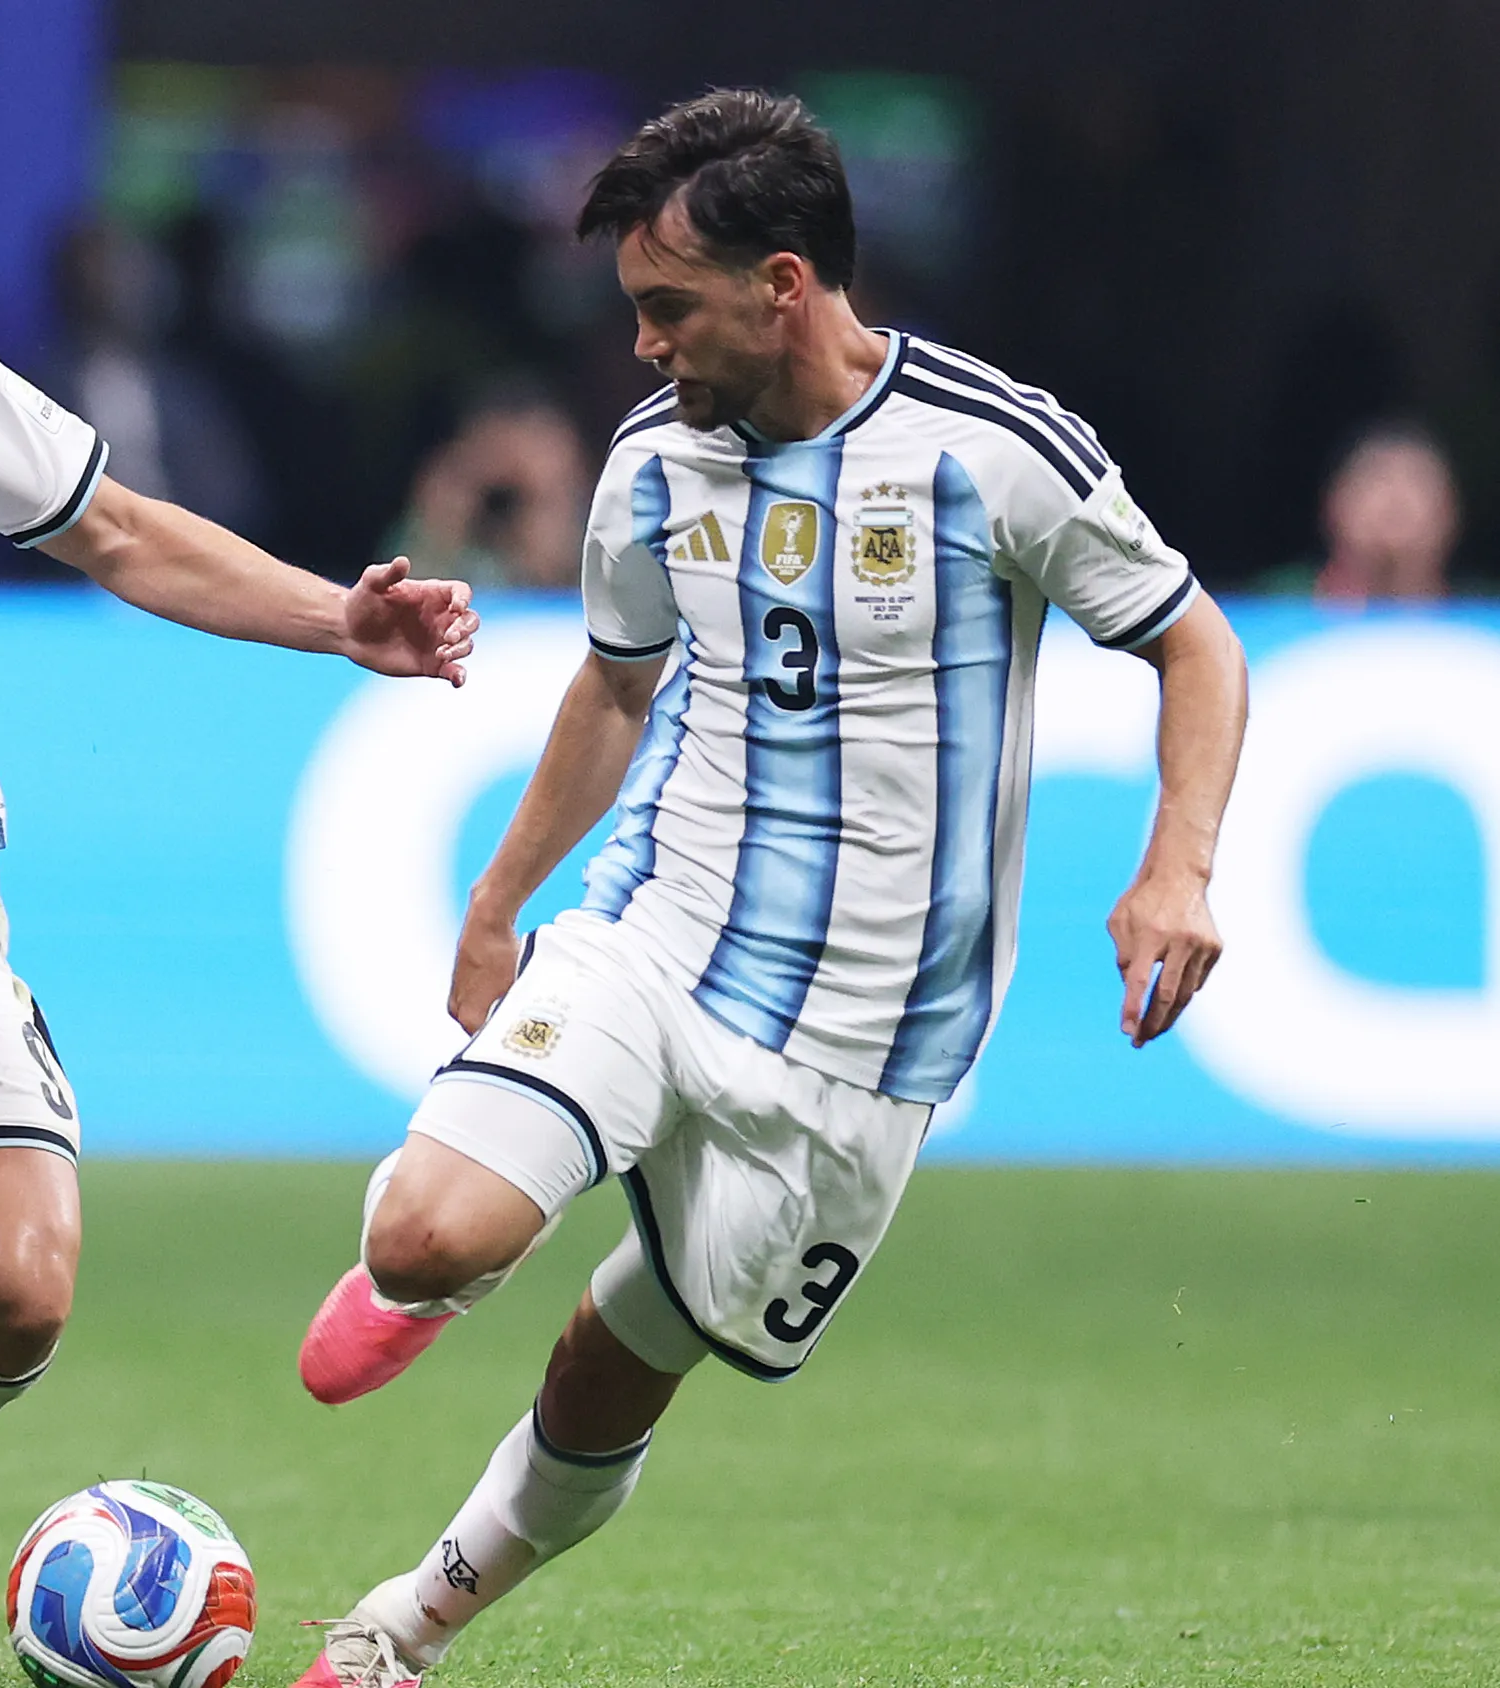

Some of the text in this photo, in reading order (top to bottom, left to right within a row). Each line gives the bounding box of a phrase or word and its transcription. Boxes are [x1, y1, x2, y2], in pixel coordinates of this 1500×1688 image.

[863, 527, 903, 565] AFA
[763, 606, 819, 712] 3
[21, 1020, 74, 1121] 9
[763, 1242, 860, 1343] 3
